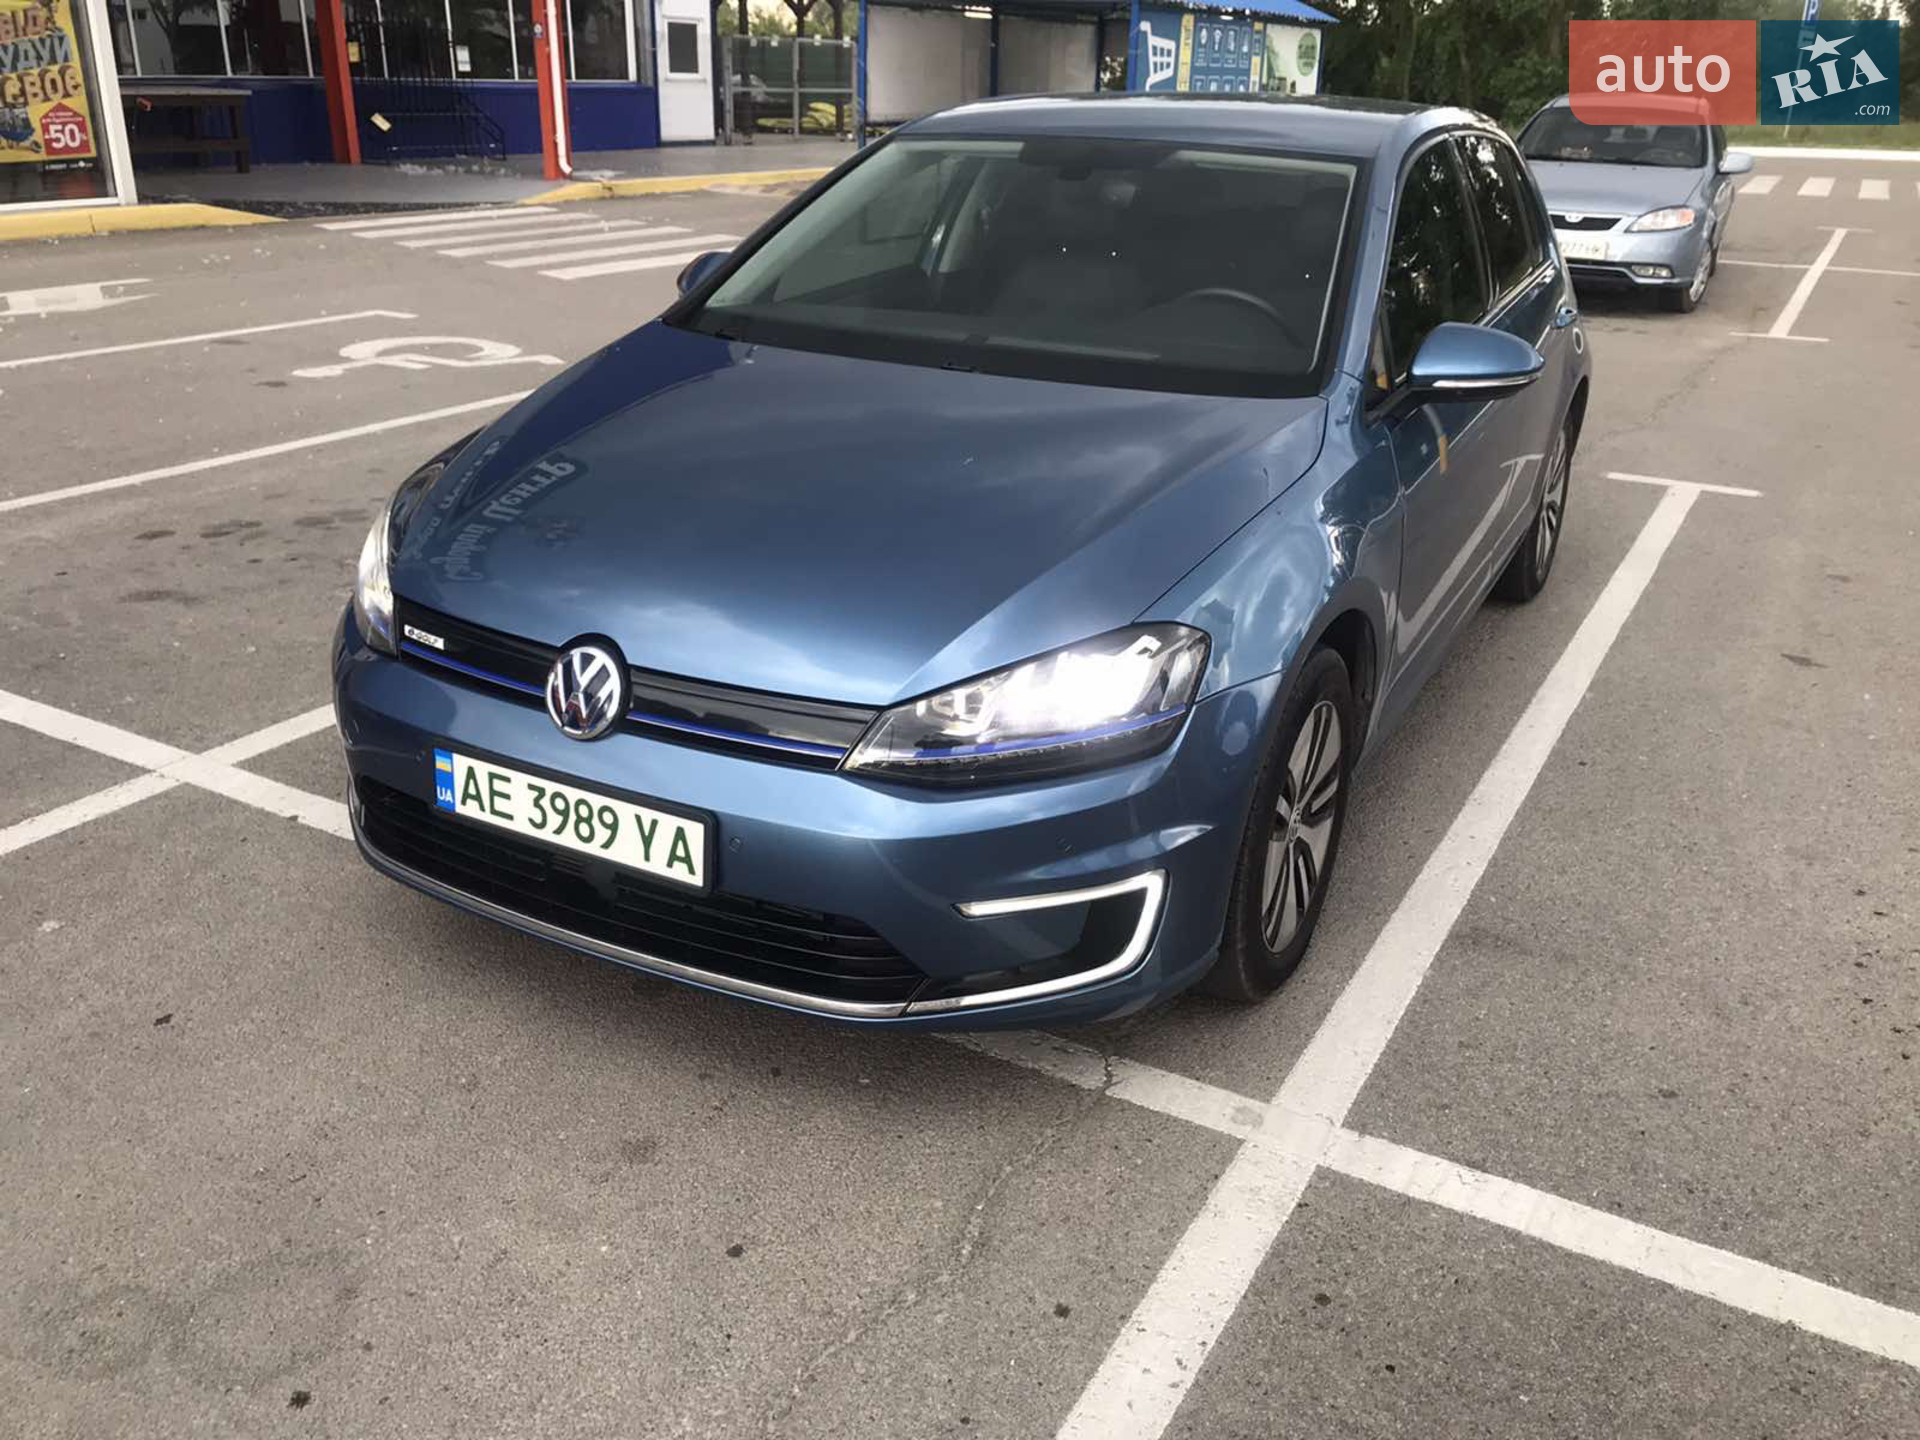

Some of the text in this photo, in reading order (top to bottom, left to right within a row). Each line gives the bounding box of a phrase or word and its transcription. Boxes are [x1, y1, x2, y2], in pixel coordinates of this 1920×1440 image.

[437, 785, 453, 803] UA
[460, 765, 696, 876] AE 3989 YA
